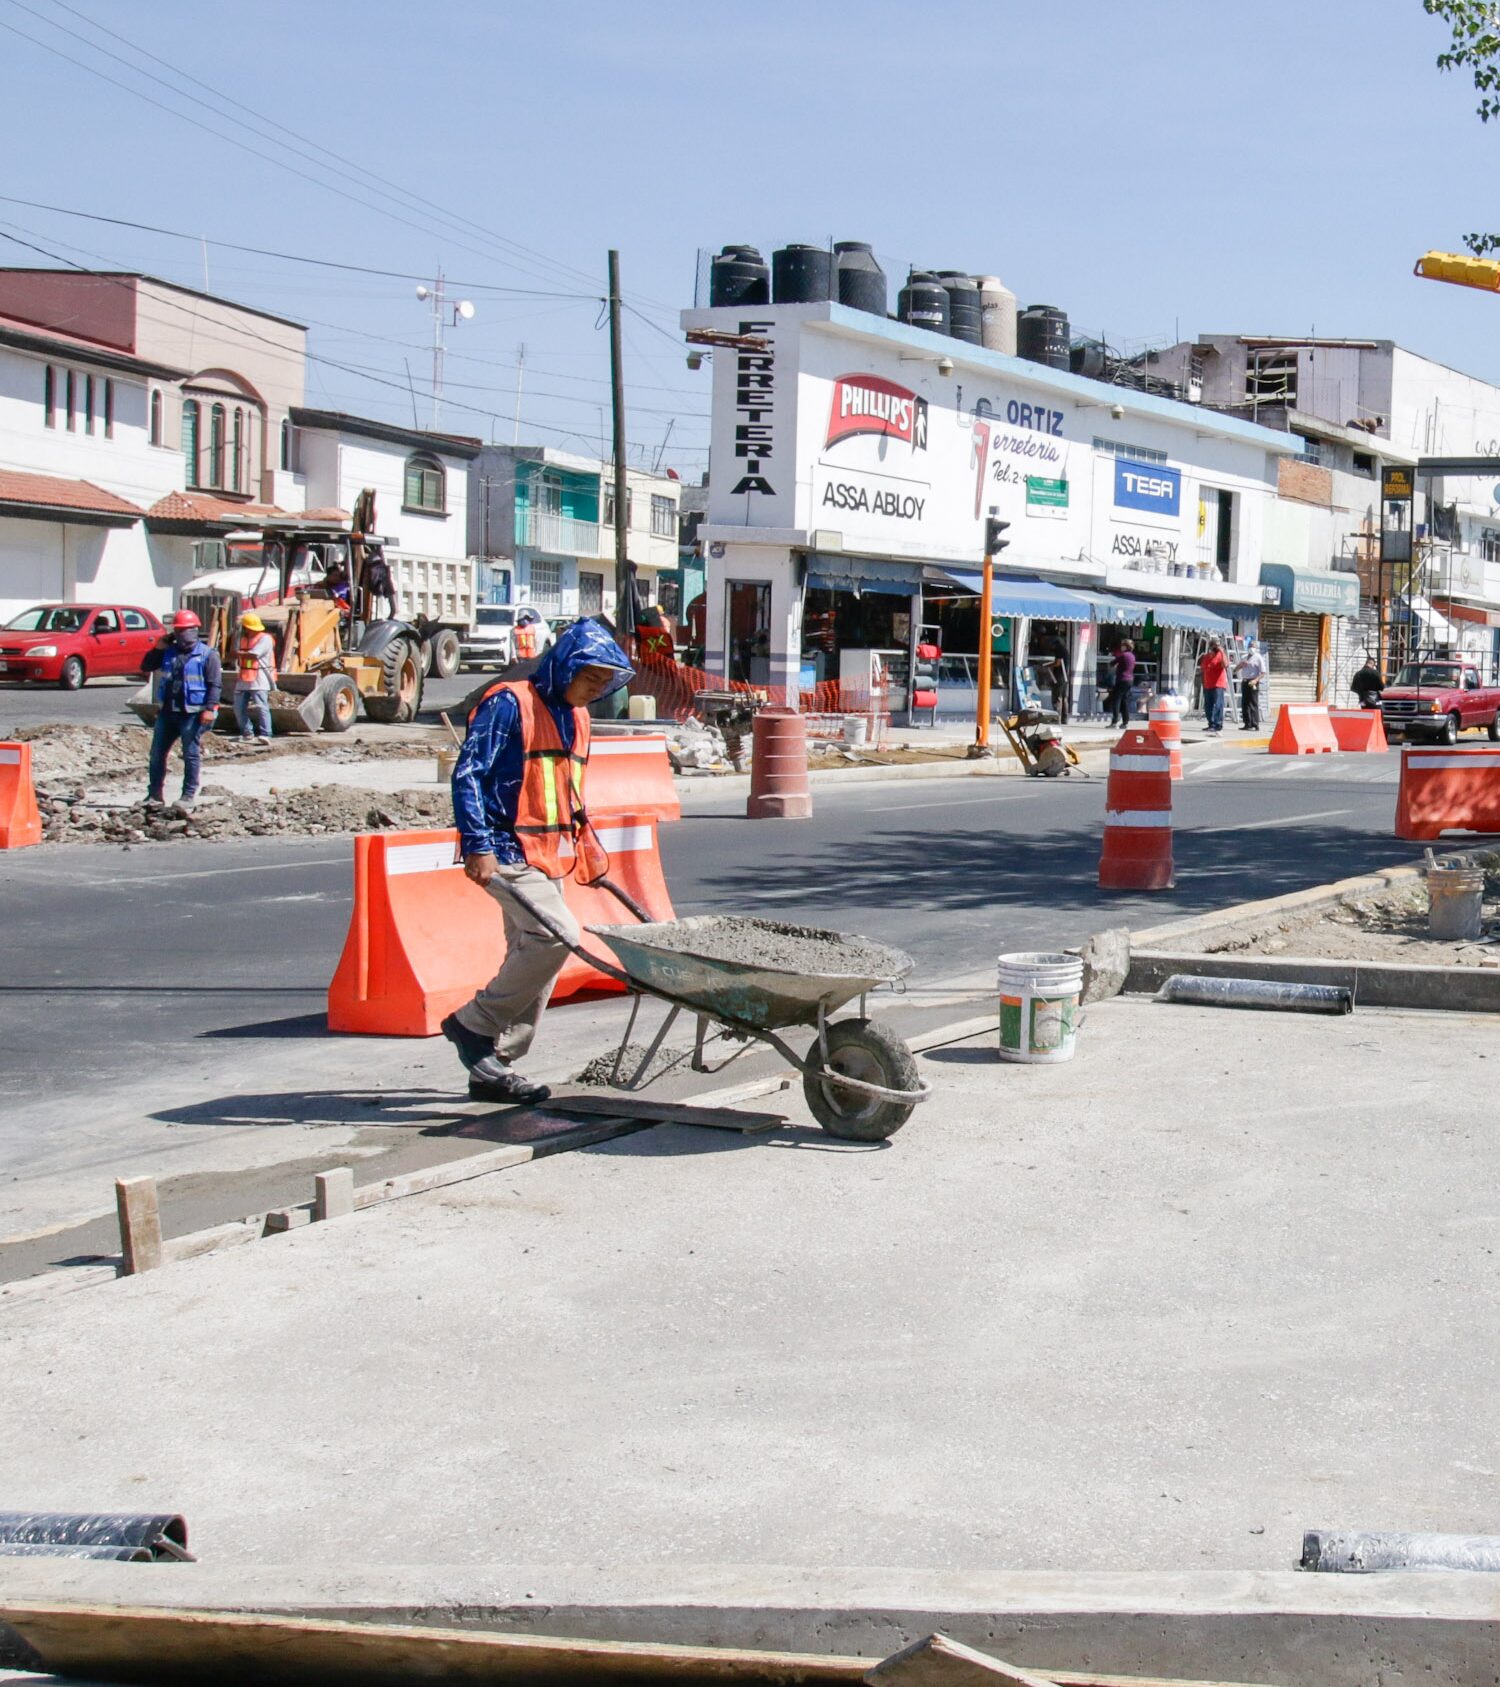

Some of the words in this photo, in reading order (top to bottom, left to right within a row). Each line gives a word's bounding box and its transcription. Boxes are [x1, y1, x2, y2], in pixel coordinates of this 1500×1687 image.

[840, 383, 910, 432] PHILLIPS
[1006, 399, 1064, 437] ORTIZ
[822, 481, 869, 513] ASSA
[872, 490, 925, 521] ABLOY
[1122, 472, 1173, 499] TESA
[1111, 533, 1142, 556] ASSA
